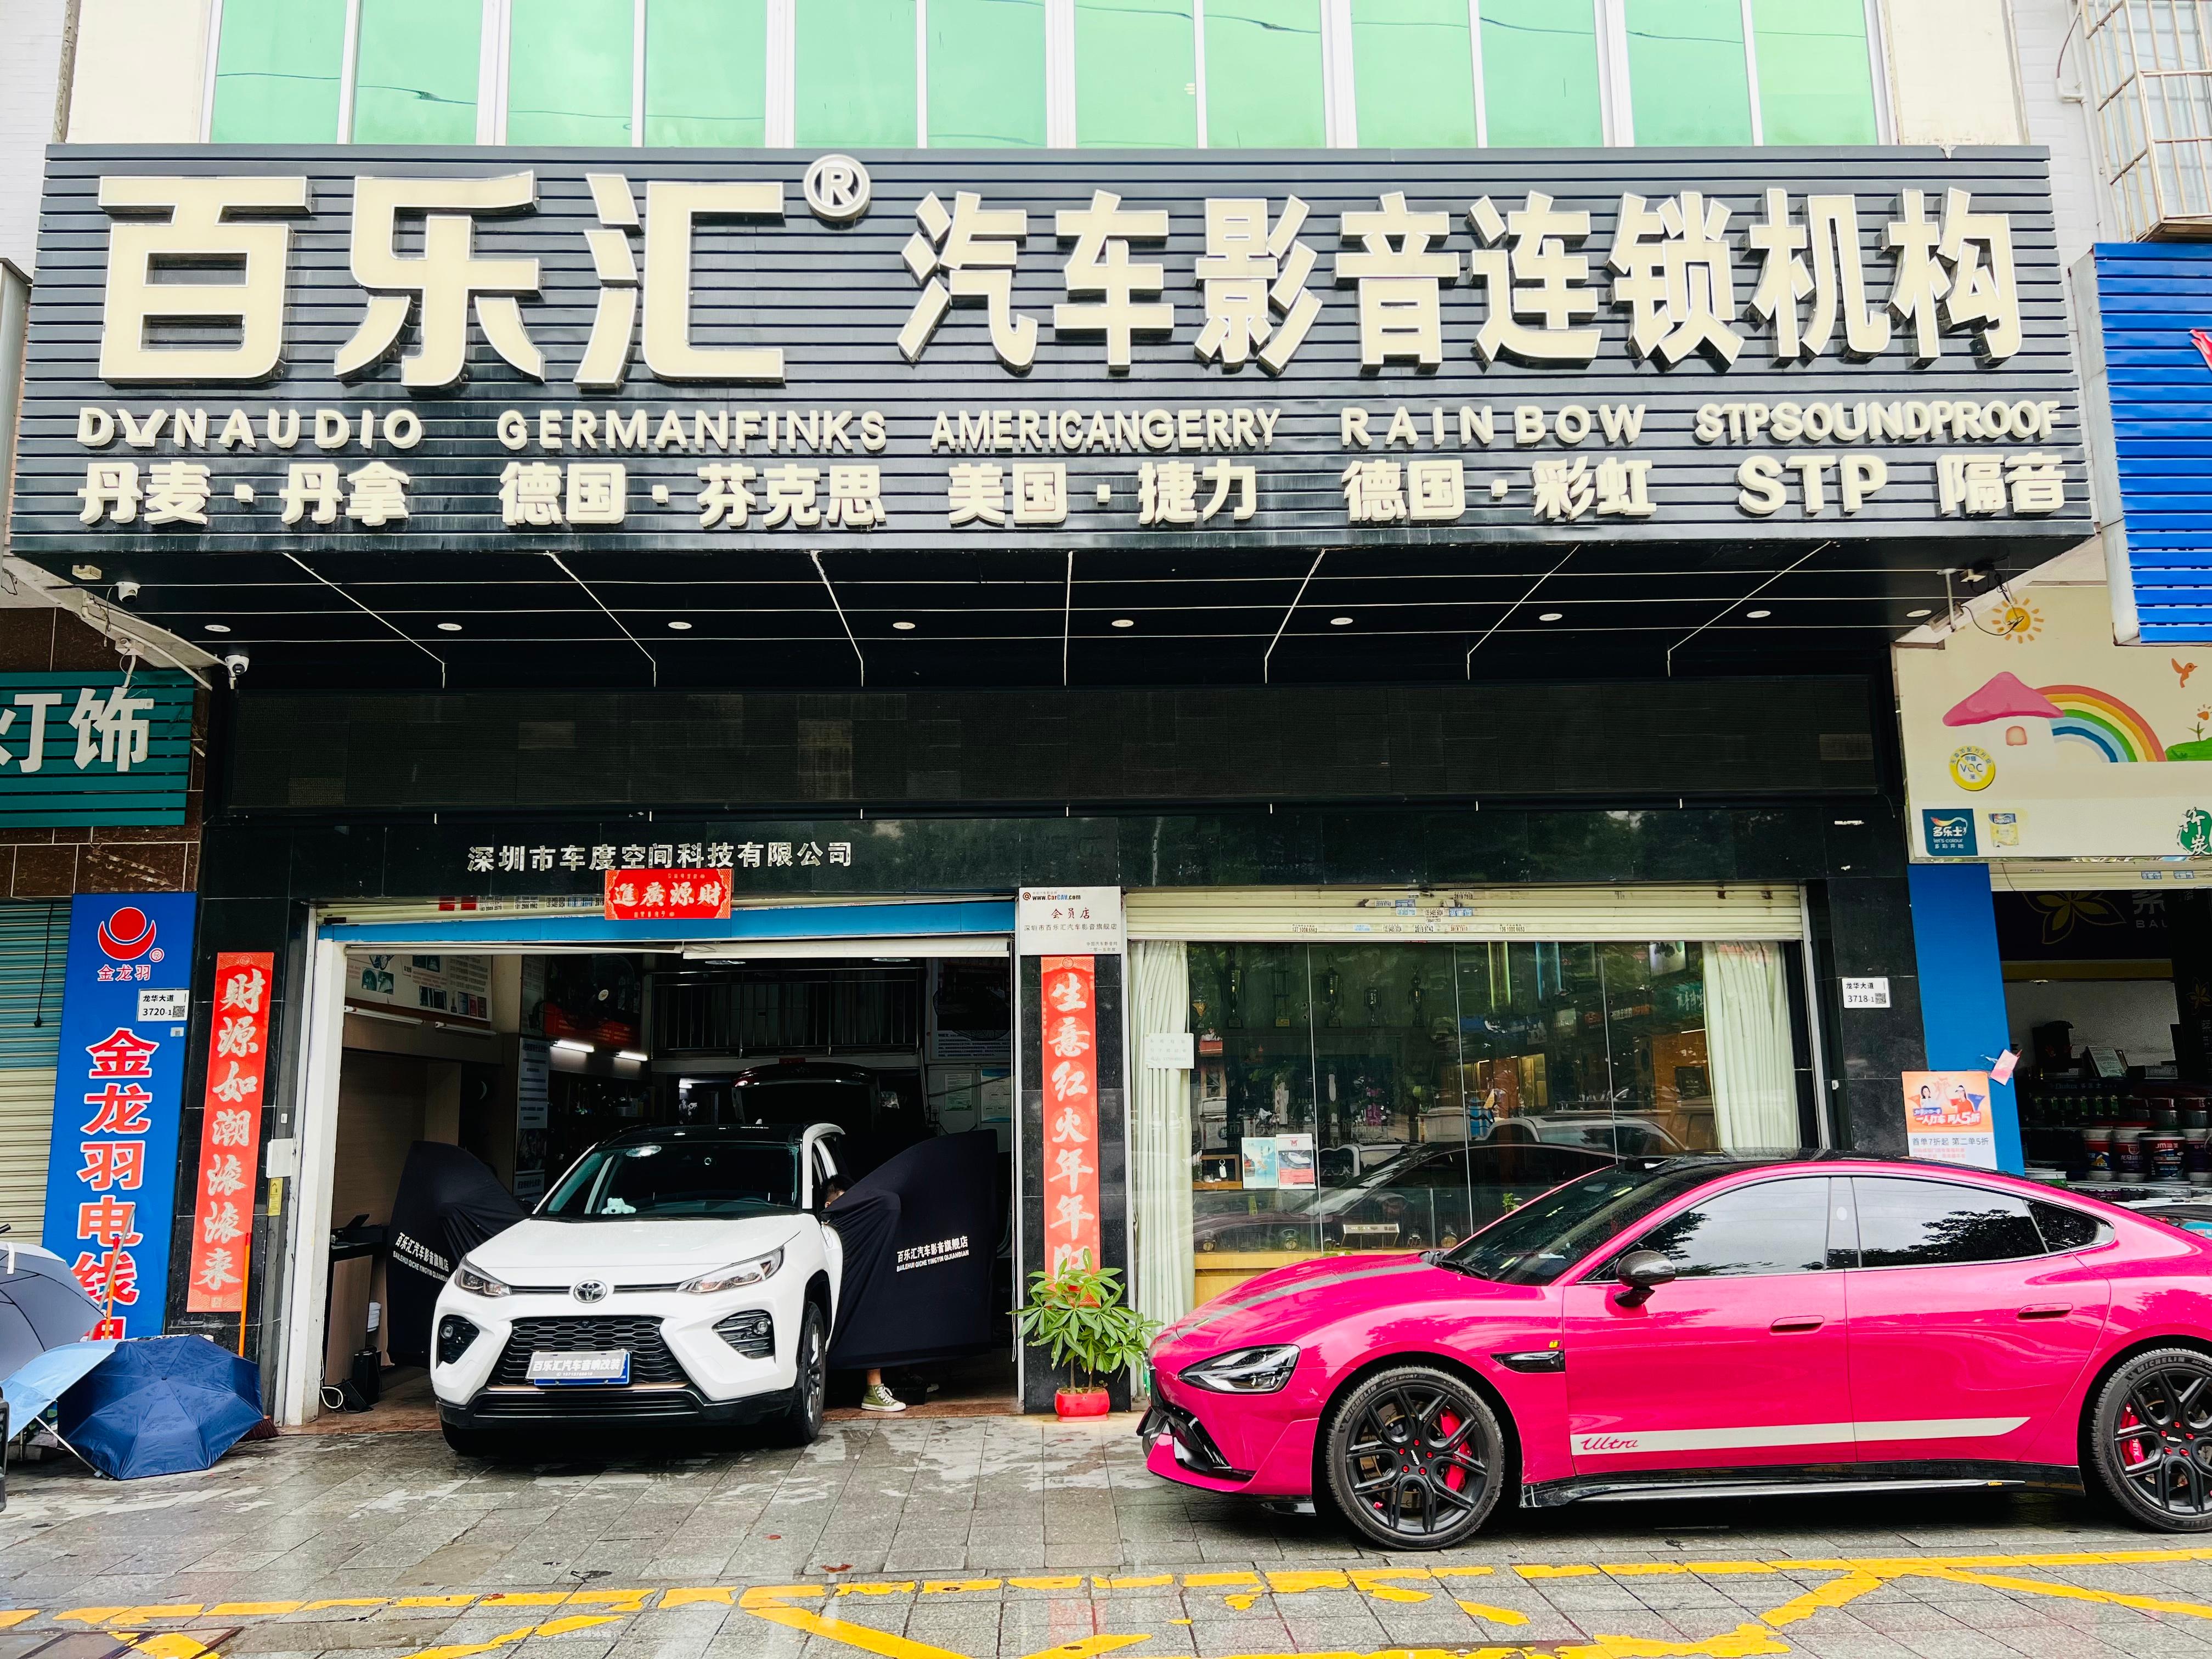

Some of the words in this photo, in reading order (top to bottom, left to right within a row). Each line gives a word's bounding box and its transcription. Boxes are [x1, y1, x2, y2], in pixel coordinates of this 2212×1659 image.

[98, 171, 785, 387] 百乐汇
[898, 187, 2023, 374] 汽车影音连锁机构
[77, 407, 422, 449] DYNAUDIO
[497, 409, 886, 451] GERMANFINKS
[929, 407, 1280, 453] AMERICANGERRY
[1695, 400, 2061, 443] STPSOUNDPROOF
[1737, 455, 1888, 515] STP
[1936, 452, 2067, 515] 隔音
[1933, 826, 1963, 837] 多乐士
[467, 842, 853, 871] 深圳市车度空间科技有限公司
[1051, 907, 1090, 919] 会员店
[1024, 923, 1118, 932] 深圳市百乐汇汽车影音旗舰店
[98, 964, 151, 981] 金龙羽
[896, 1235, 968, 1263] 百乐汇汽车影音旗舰店
[915, 1260, 927, 1268] QICHE
[927, 1255, 944, 1265] YINGYIN
[944, 1250, 969, 1261] QIJIANDIAN
[533, 1359, 621, 1372] 百乐汇汽车音响改装
[2136, 1356, 2186, 1374] MICHELIN
[1344, 1384, 1378, 1422] MICHELIN
[1382, 1376, 1397, 1386] PILOT
[1580, 1436, 1639, 1451] Ultra
